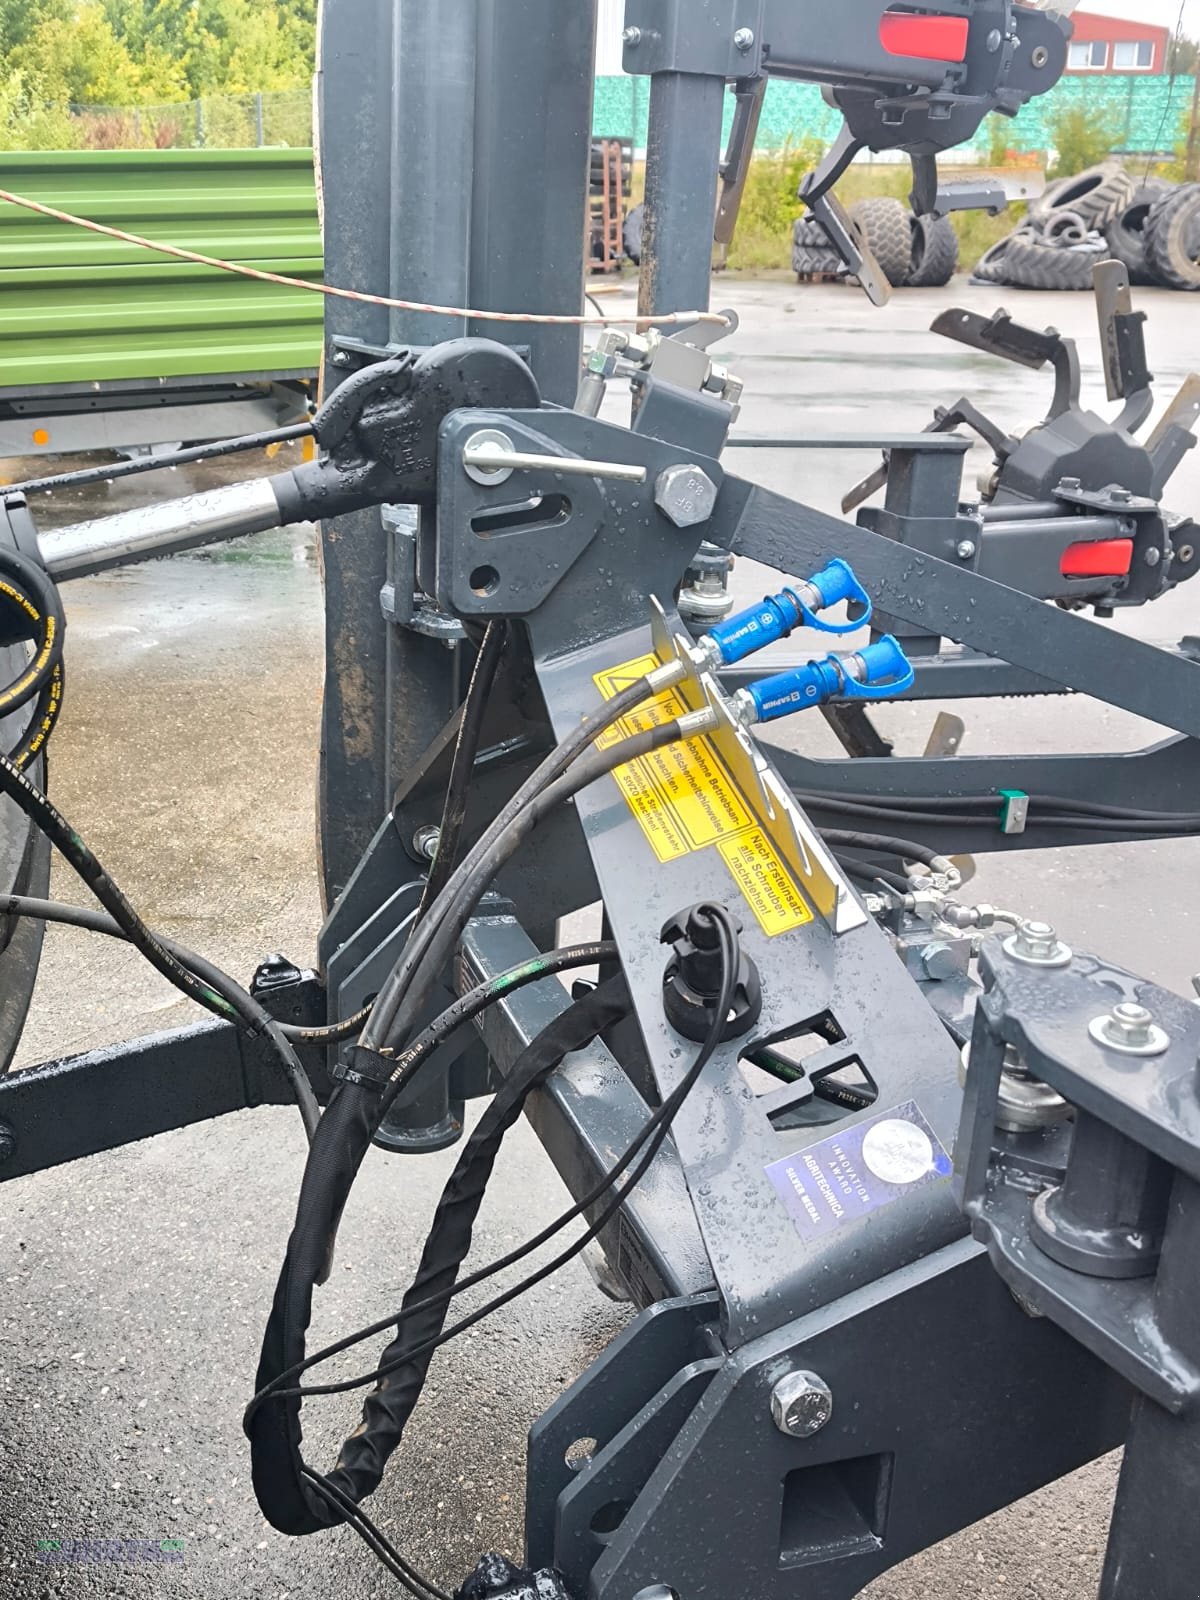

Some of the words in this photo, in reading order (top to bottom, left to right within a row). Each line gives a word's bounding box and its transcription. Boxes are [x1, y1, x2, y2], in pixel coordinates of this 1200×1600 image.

[762, 694, 791, 710] SAPHIR
[653, 754, 679, 794] beachten.
[663, 702, 675, 717] Vor
[709, 777, 740, 825] Betriebsan-
[636, 797, 658, 832] beachten!
[673, 754, 724, 833] Sicherheitshinweise
[647, 798, 680, 852] Straßenverkehr
[731, 857, 772, 915] nachziehen!
[738, 845, 755, 864] alle
[752, 864, 786, 917] Schrauben
[751, 835, 770, 861] Nach
[766, 862, 803, 917] Ersteinsatz
[785, 1167, 805, 1197] SILVER
[801, 1194, 822, 1224] MEDAL
[802, 1153, 845, 1219] AGRITECHNICA
[827, 1161, 853, 1195] AWARD
[831, 1143, 871, 1203] INNOVATION
